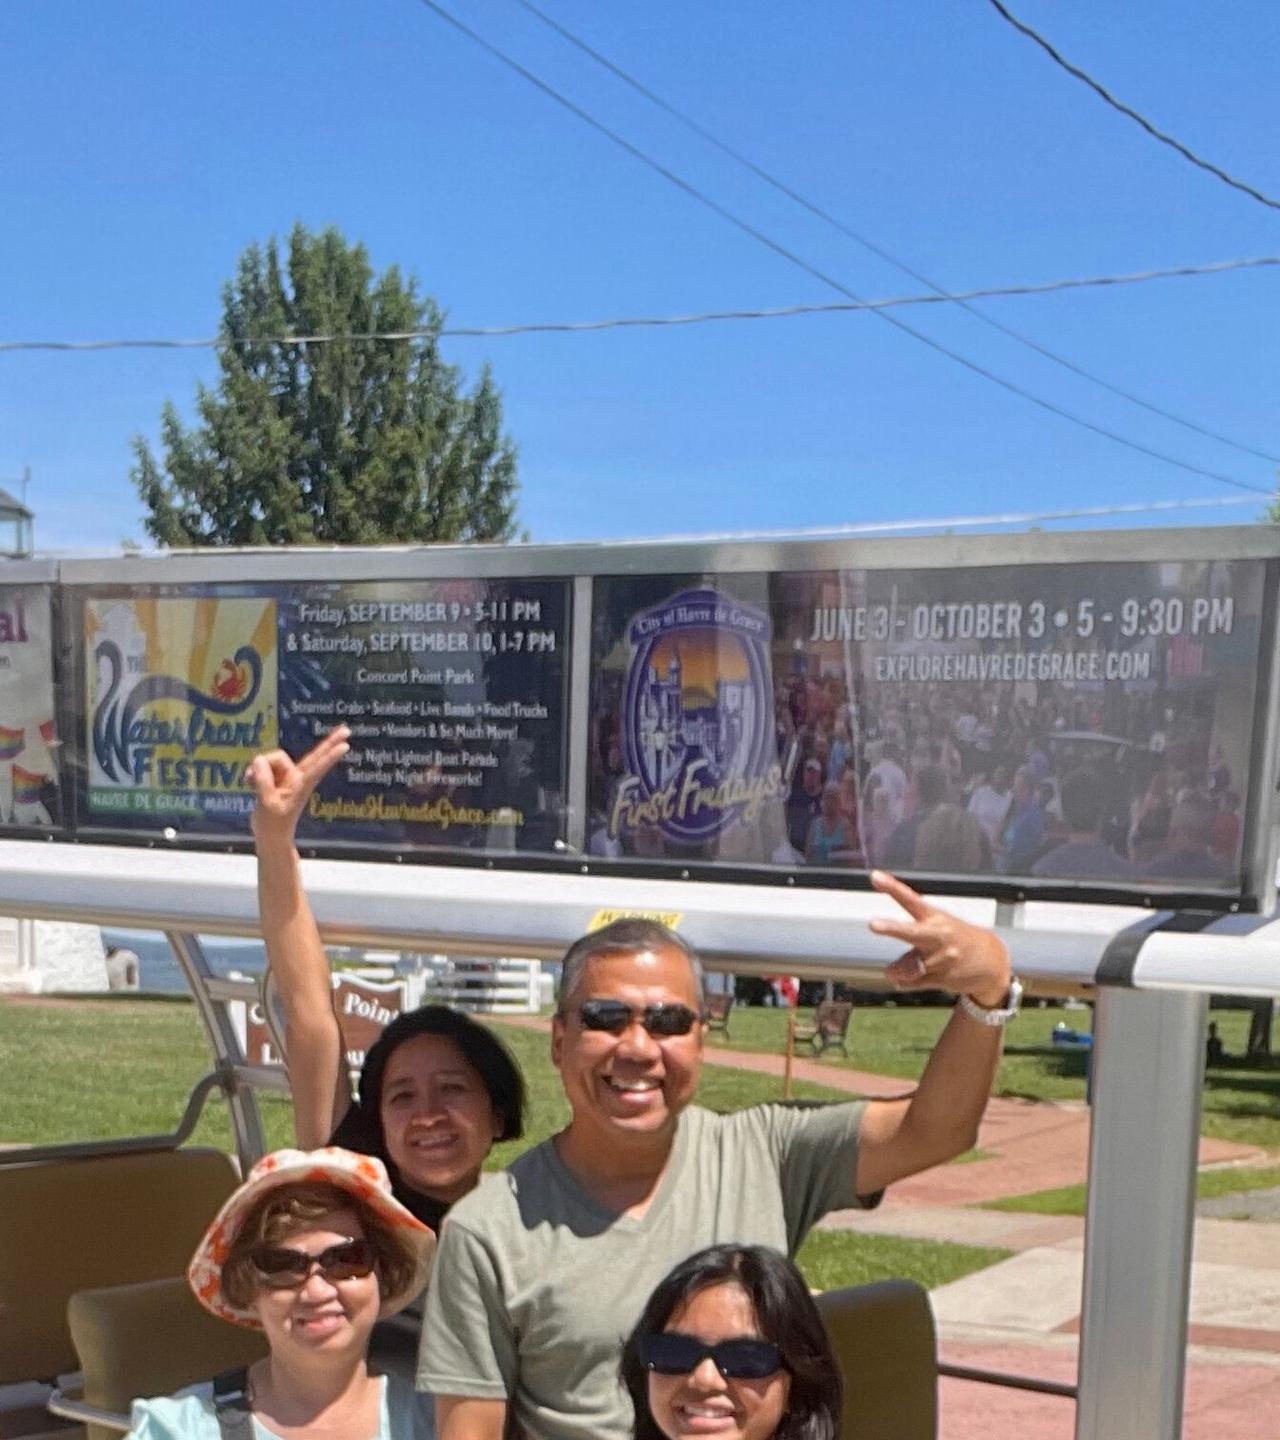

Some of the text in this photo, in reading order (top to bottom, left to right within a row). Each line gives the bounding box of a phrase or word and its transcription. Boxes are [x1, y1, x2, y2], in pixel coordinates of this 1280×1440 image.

[299, 604, 348, 627] Friday,
[349, 602, 447, 623] SEPTEMBER
[512, 600, 542, 622] PM
[810, 608, 867, 641] JUNE
[873, 607, 891, 640] 3
[917, 603, 1022, 640] OCTOBER
[1028, 602, 1047, 638] 3
[1077, 601, 1095, 638] 5
[1120, 598, 1183, 636] 9:30
[1191, 597, 1234, 635] PM
[287, 634, 298, 651] &
[302, 633, 368, 657] Saturday,
[369, 632, 470, 651] SEPTEMBER
[528, 632, 556, 652] PM
[357, 669, 475, 684] Concord Point Park
[875, 651, 1151, 682] EXPLOREHAVREDEGRACE.COM
[512, 702, 549, 719] Trucks
[608, 740, 799, 841] First Fridays!
